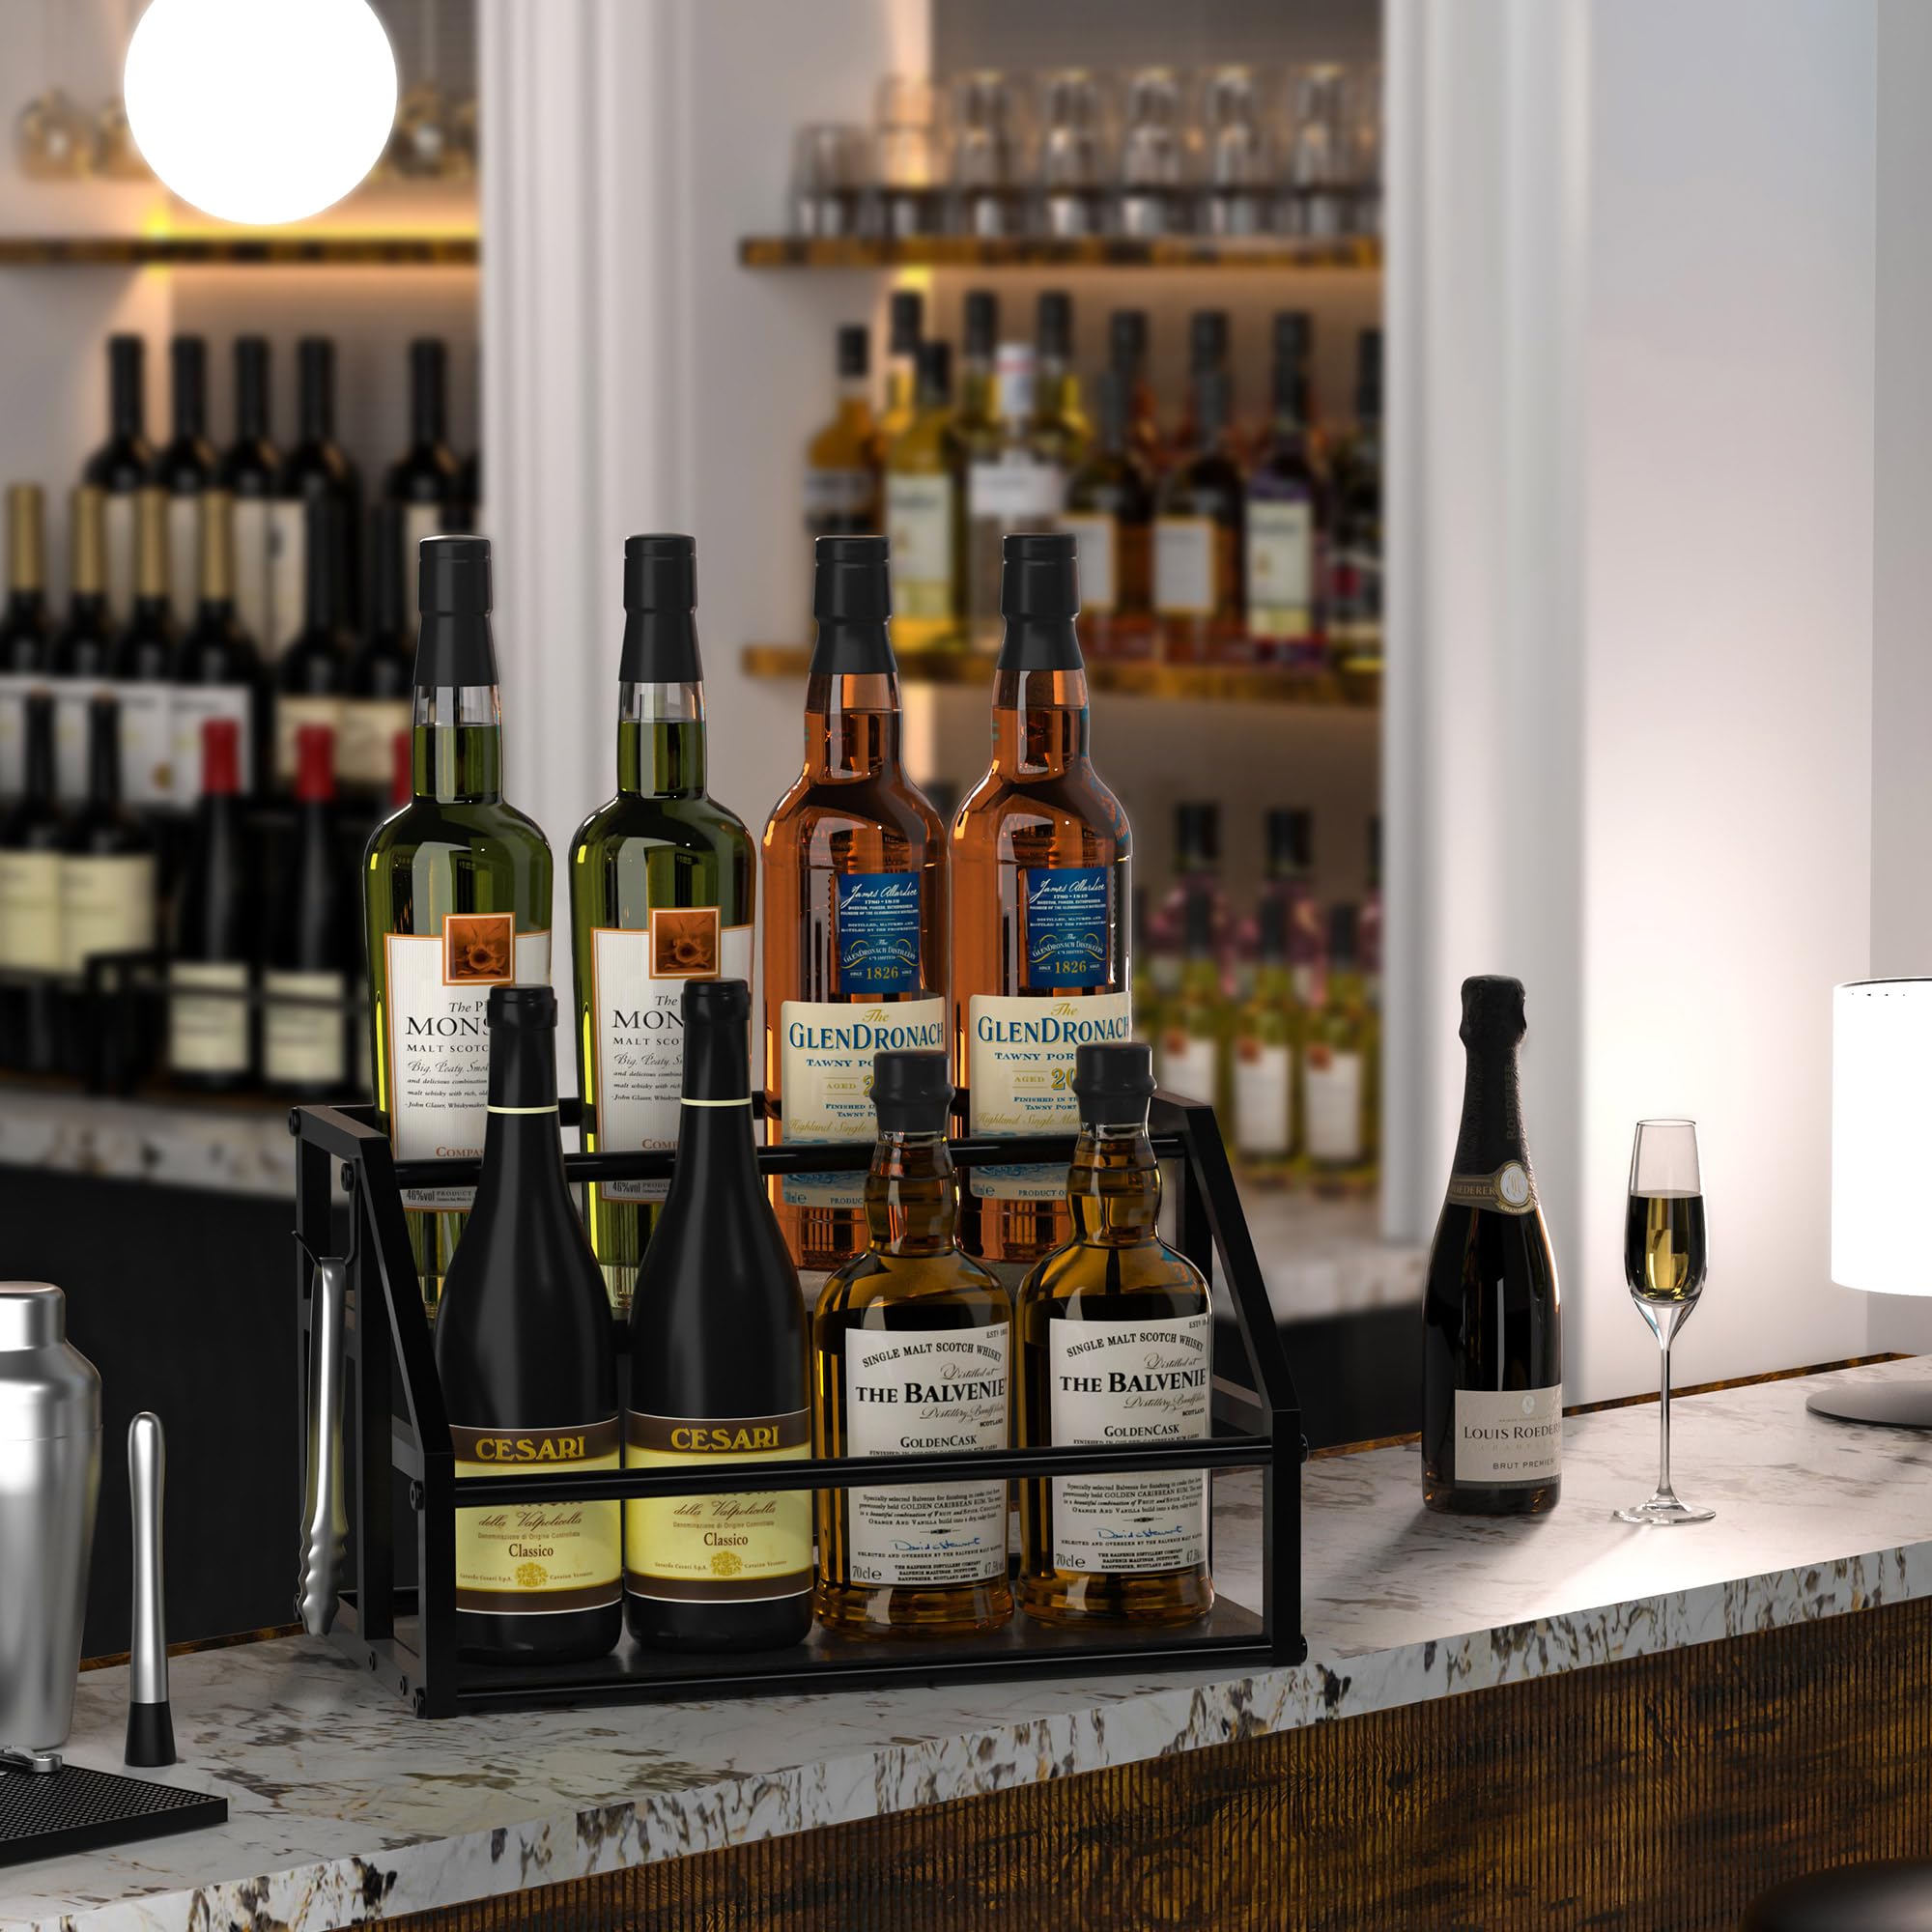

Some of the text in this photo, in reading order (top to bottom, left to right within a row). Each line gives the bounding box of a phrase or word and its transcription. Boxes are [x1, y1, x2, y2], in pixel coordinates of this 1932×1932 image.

[840, 883, 879, 909] James
[1029, 878, 1067, 903] James
[867, 966, 898, 980] 1826
[1055, 960, 1087, 974] 1826
[449, 1002, 471, 1012] The
[655, 995, 678, 1006] The
[862, 1009, 890, 1022] The
[1050, 1003, 1078, 1016] The
[806, 1059, 852, 1067] TAWNY
[994, 1052, 1041, 1061] TAWNY
[789, 1119, 867, 1136] Highland Single
[977, 1113, 1021, 1128] Highland
[1023, 1114, 1056, 1128] Single
[1066, 1332, 1205, 1358] SINGLE MALT SCOTCH WHISKY
[862, 1342, 1003, 1368] SINGLE MALT SCOTCH WHISKY
[1144, 1352, 1187, 1370] Distilled
[940, 1362, 984, 1380] Distilled
[1060, 1368, 1207, 1393] THE BALVENIE
[856, 1378, 1005, 1404] THE BALVENIE
[670, 1426, 780, 1451] CESARI
[1463, 1426, 1509, 1440] LOUIS
[475, 1435, 586, 1462] CESARI
[1492, 1462, 1520, 1470] BRUT
[1137, 1489, 1175, 1497] CARIBBEAN
[673, 1500, 777, 1520] della Valpolicella
[478, 1511, 583, 1531] della Valpolicella
[703, 1532, 749, 1546] Classico
[508, 1543, 554, 1557] Classico
